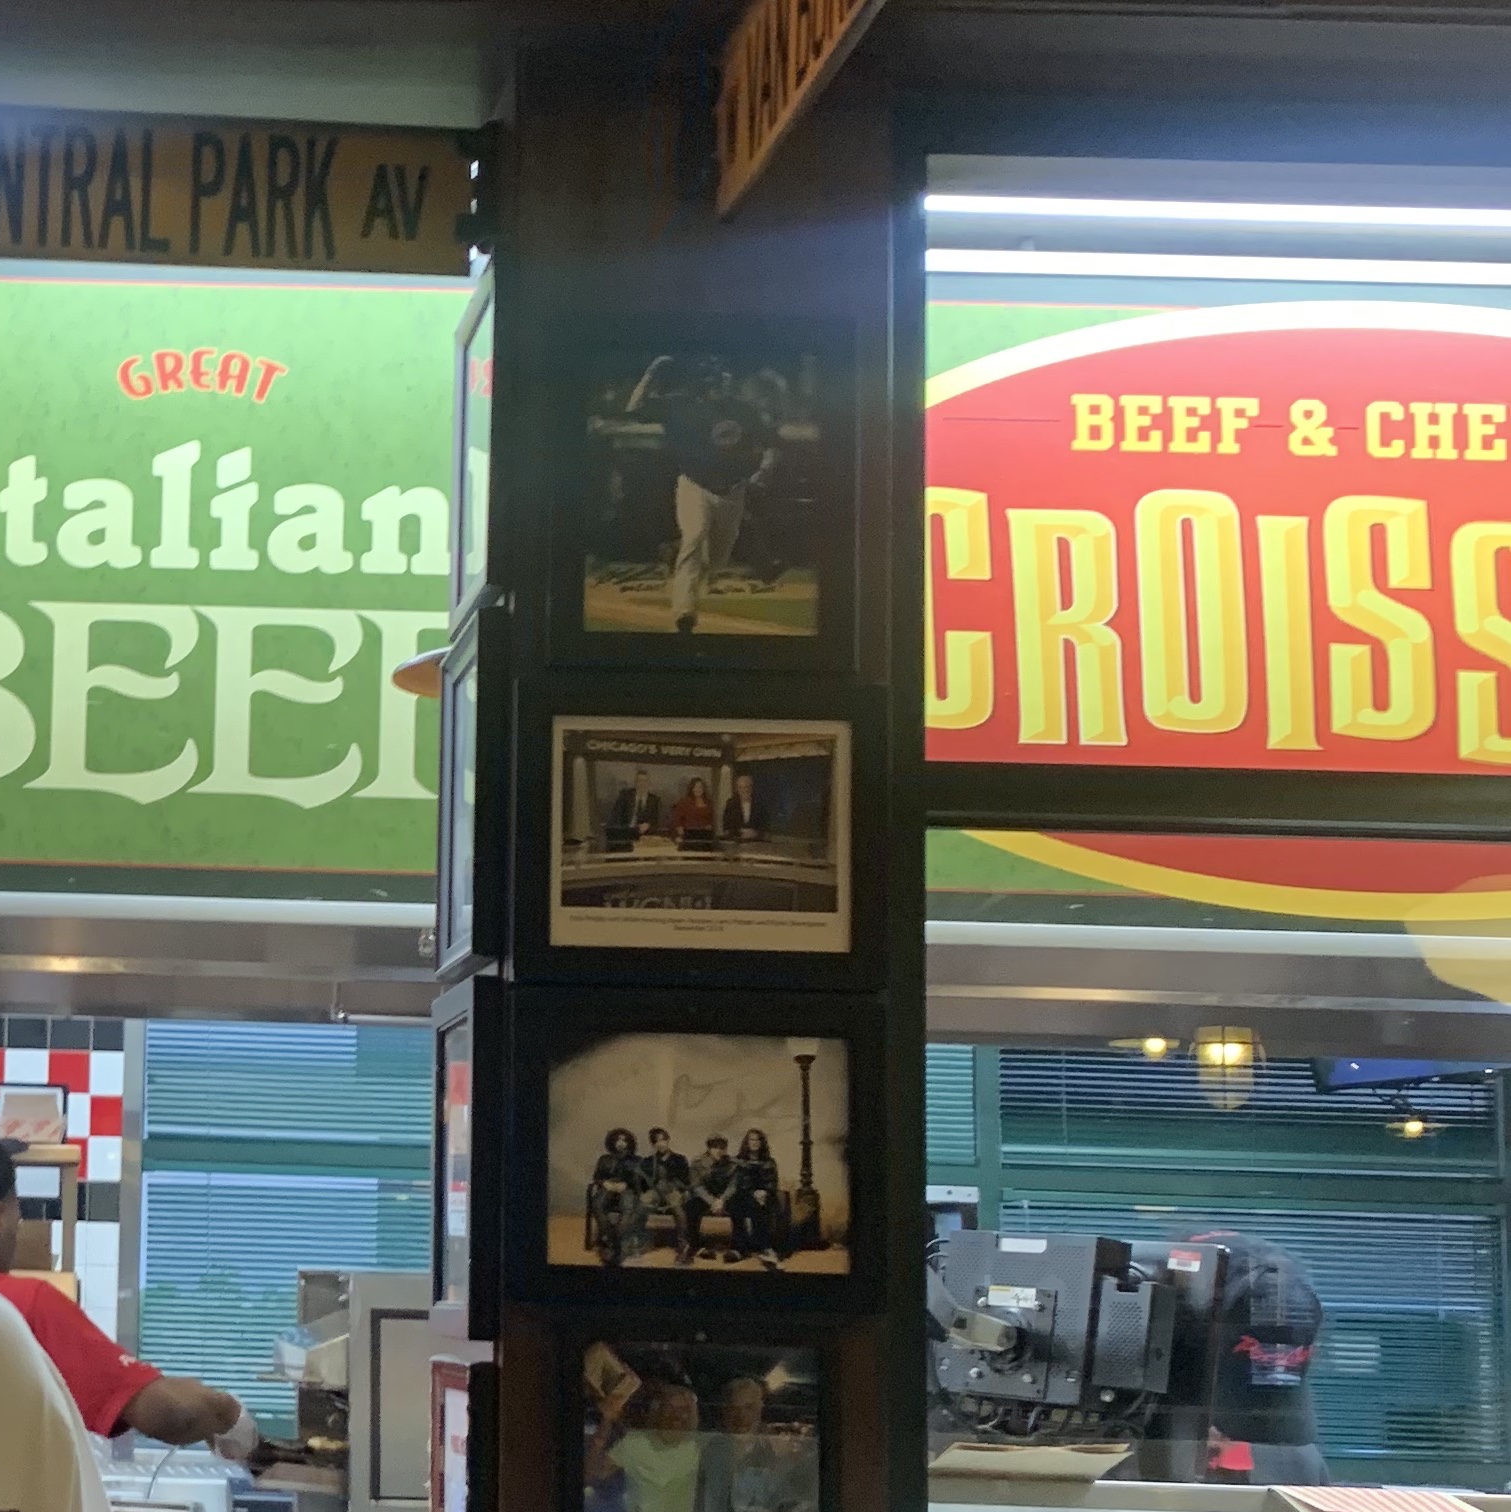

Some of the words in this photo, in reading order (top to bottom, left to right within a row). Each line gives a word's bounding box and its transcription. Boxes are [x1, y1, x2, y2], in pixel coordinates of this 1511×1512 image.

[190, 130, 340, 260] PARK
[361, 163, 430, 241] AV
[117, 347, 289, 404] GREAT
[1070, 393, 1259, 454] BEEF
[1288, 399, 1338, 457] &
[1365, 401, 1508, 461] CHE
